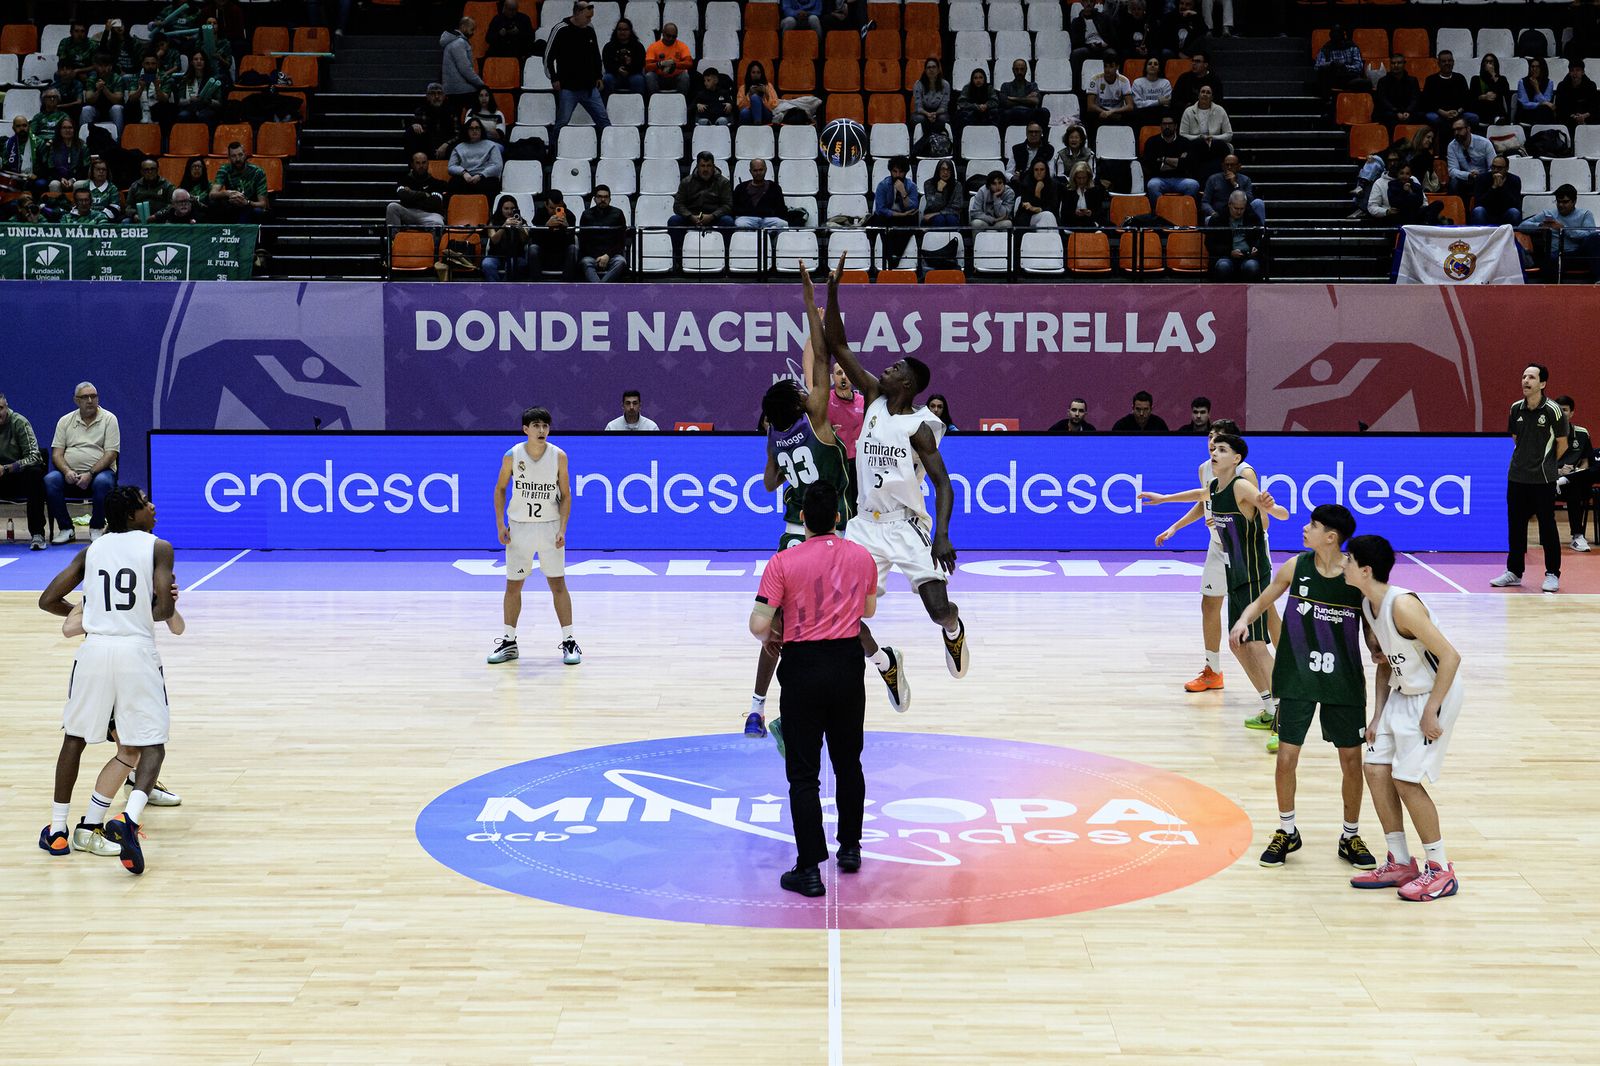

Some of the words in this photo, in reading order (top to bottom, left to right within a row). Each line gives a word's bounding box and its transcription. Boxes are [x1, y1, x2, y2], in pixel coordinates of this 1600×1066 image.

[7, 226, 62, 238] UNICAJA
[66, 224, 118, 239] MÁLAGA
[120, 228, 149, 238] 2012
[222, 228, 231, 236] 31
[101, 241, 112, 249] 37
[31, 267, 64, 275] Fundación
[149, 267, 182, 275] Fundación
[415, 309, 611, 352] DONDE
[627, 309, 811, 353] NACEN
[840, 310, 923, 354] AS
[940, 310, 1216, 354] ESTRELLAS
[864, 441, 907, 459] Emirates
[777, 446, 819, 488] 33
[204, 459, 459, 514] endesa
[515, 480, 556, 492] Emirates
[575, 460, 784, 514] ndesa
[921, 460, 1143, 514] ndesa
[1261, 461, 1471, 515] ndesa
[522, 490, 530, 498] FLY
[531, 491, 550, 499] BETTER
[527, 502, 542, 518] 12
[452, 559, 1204, 577] VALCIA
[98, 568, 137, 612] 19
[1313, 604, 1355, 618] Fundación
[1313, 612, 1343, 624] Unicaja
[1309, 651, 1335, 674] 38
[465, 831, 570, 842] acb
